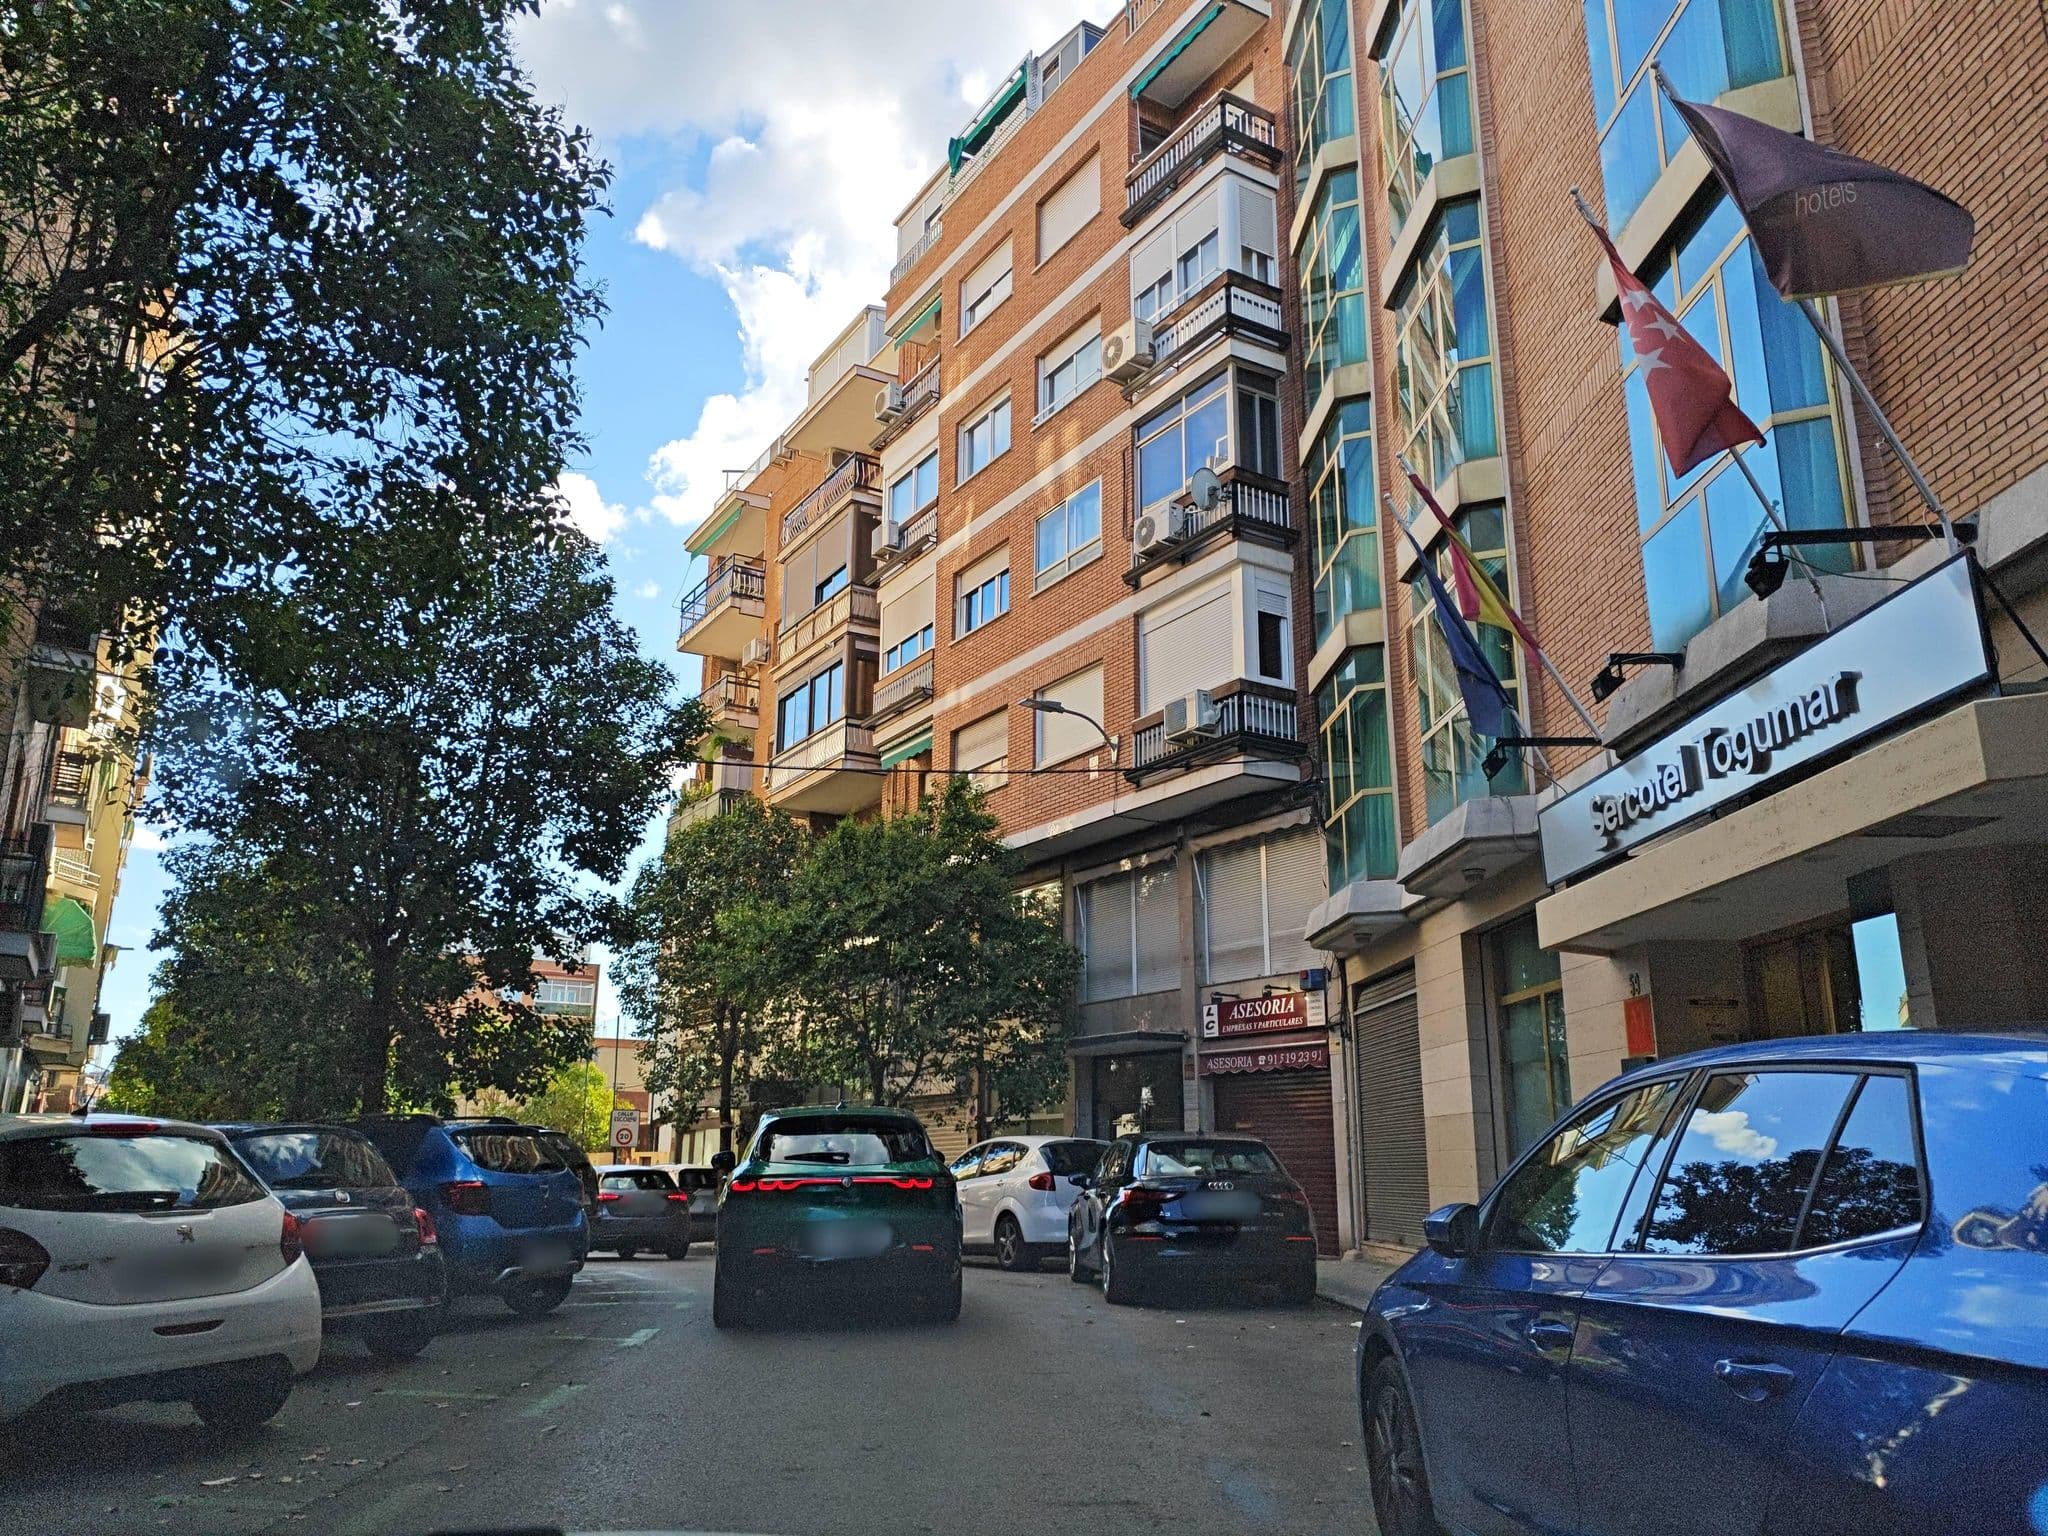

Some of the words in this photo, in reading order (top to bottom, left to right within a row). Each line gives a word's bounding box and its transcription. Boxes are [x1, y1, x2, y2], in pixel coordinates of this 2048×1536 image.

[1795, 182, 1857, 217] hotels
[1589, 745, 1690, 837] Sercotel
[1691, 672, 1857, 775] Togumar
[1206, 1006, 1215, 1017] L
[1229, 997, 1295, 1020] ASESORIA
[1222, 1021, 1253, 1034] EMPRESAS
[1252, 1020, 1258, 1030] Y
[1257, 1016, 1304, 1030] PARTICULARES
[1207, 1055, 1253, 1070] ASESORIA
[1267, 1054, 1277, 1065] 91
[1280, 1052, 1296, 1064] 519
[1298, 1050, 1310, 1063] 23
[1311, 1049, 1322, 1062] 91
